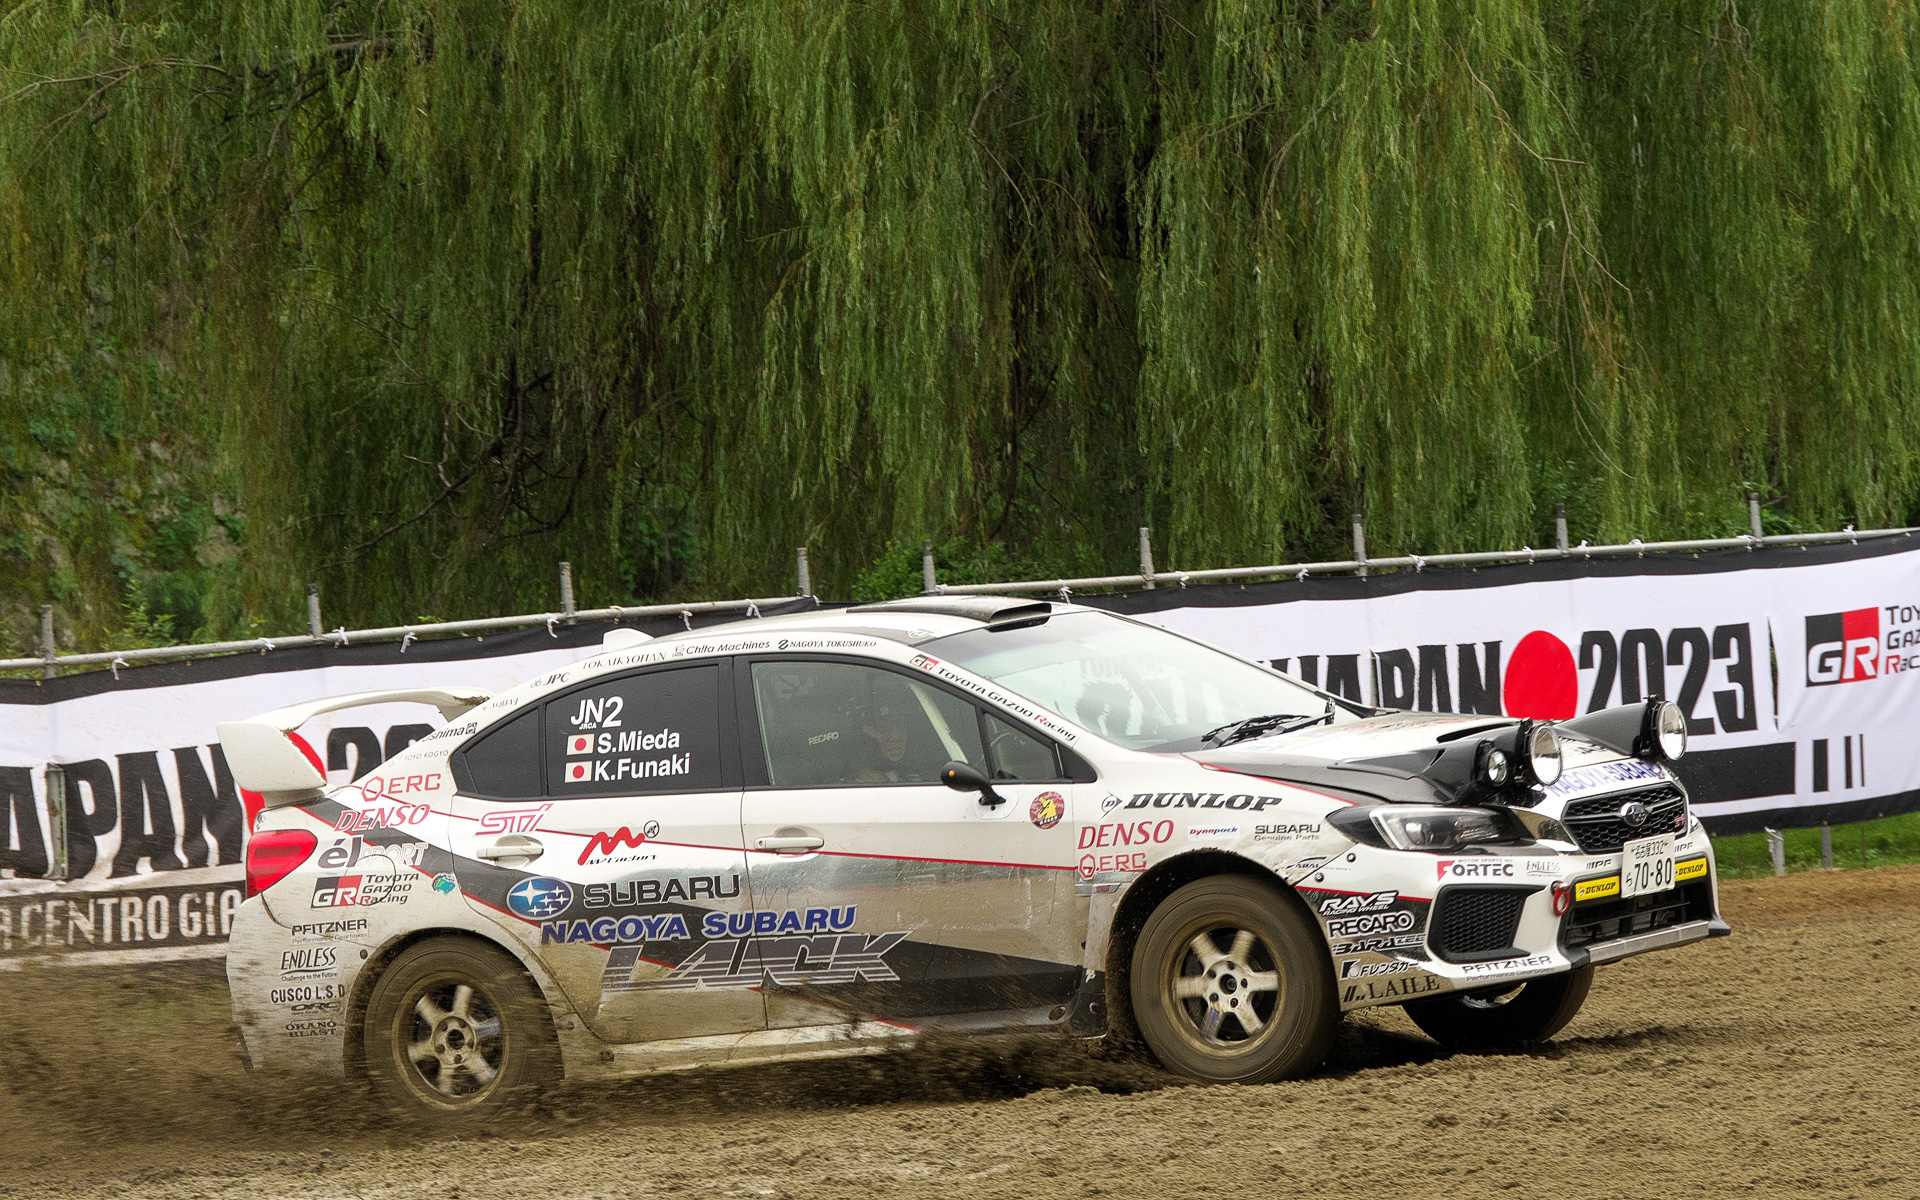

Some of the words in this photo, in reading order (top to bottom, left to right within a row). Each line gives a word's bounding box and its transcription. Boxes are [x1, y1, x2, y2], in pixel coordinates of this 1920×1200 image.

[717, 640, 770, 652] Machines
[789, 640, 824, 648] NAGOYA
[826, 640, 877, 648] TOKUSHUKO
[1807, 636, 1879, 684] GR
[1579, 622, 1758, 738] 2023
[570, 696, 624, 729] JN2
[938, 667, 986, 695] TOYOTA
[987, 691, 1033, 717] GAZOO
[1034, 714, 1076, 741] Racing
[597, 729, 680, 755] S.Mieda
[808, 732, 839, 746] RECARO
[594, 753, 691, 782] K.Funaki
[388, 774, 441, 794] ERC
[1123, 792, 1282, 811] DUNLOP
[335, 804, 431, 831] DENSO
[1078, 820, 1174, 850] DENSO
[1189, 826, 1238, 836] Dynapack
[1254, 834, 1292, 842] Genuine
[1255, 824, 1320, 835] SUBARU
[1100, 852, 1147, 872] ERC
[1526, 861, 1560, 872] ENDLESS
[1678, 864, 1703, 876] DUNLOP
[366, 873, 418, 884] TOYOTA
[1633, 857, 1673, 892] 70-80
[312, 886, 358, 908] GR
[362, 883, 412, 894] GAZOO
[583, 874, 741, 909] SUBARU
[1585, 882, 1616, 895] DUNLOP
[361, 894, 408, 905] Racing
[1320, 890, 1399, 913] RAYS
[20, 893, 170, 945] CENTRO
[1323, 907, 1357, 916] RACING
[1359, 904, 1390, 913] WHEEL
[291, 919, 368, 936] PFITZNER
[540, 912, 692, 946] NAGOYA
[700, 904, 858, 939] SUBARU
[1328, 911, 1413, 938] RECARO
[281, 947, 337, 970] ENDLESS
[1462, 955, 1552, 974] PFITZNER
[281, 973, 305, 982] Challenge
[1466, 971, 1516, 981] Performance
[1517, 966, 1556, 976] Gearboxes
[271, 986, 312, 1004] CUSCO
[1368, 975, 1441, 1000] LAILE
[289, 1029, 337, 1038] BLAST
